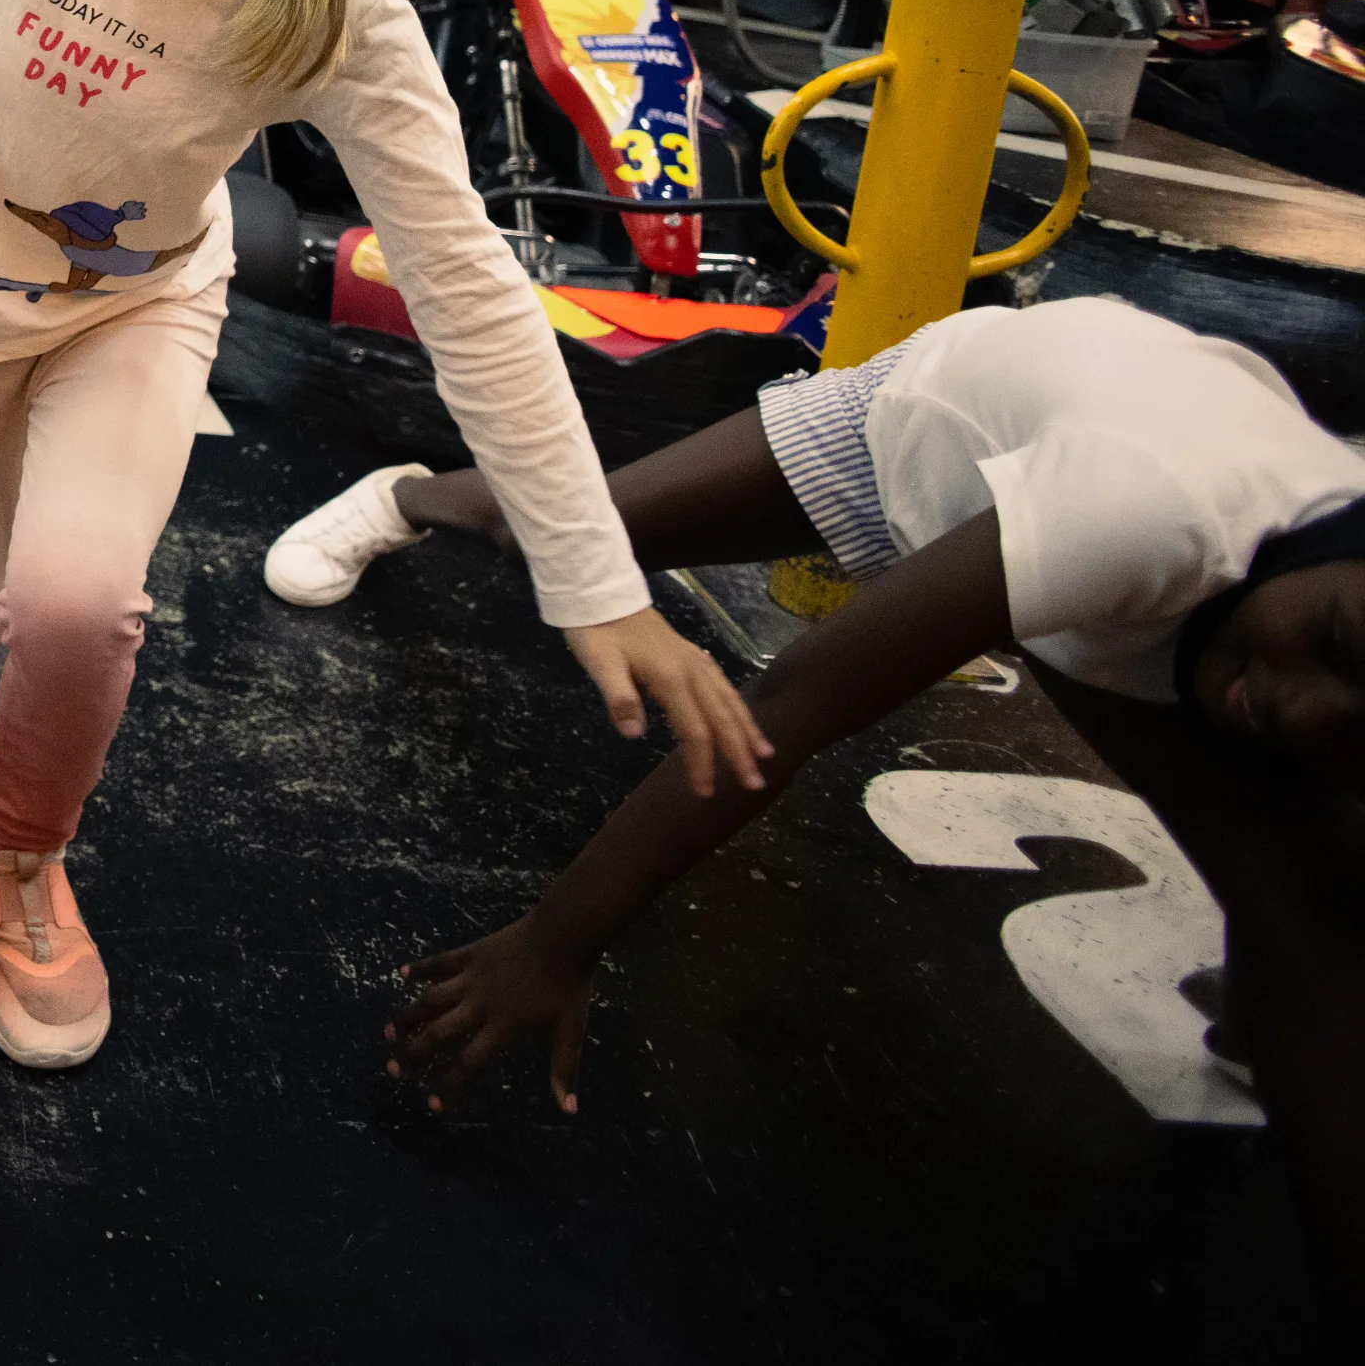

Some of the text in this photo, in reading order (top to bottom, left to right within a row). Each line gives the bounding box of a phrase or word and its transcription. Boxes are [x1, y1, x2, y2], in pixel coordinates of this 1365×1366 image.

[16, 11, 147, 91] FUNNY
[103, 17, 127, 38] IT
[126, 29, 149, 49] IS
[149, 42, 165, 58] A
[23, 57, 103, 108] DAY
[610, 129, 698, 187] 33
